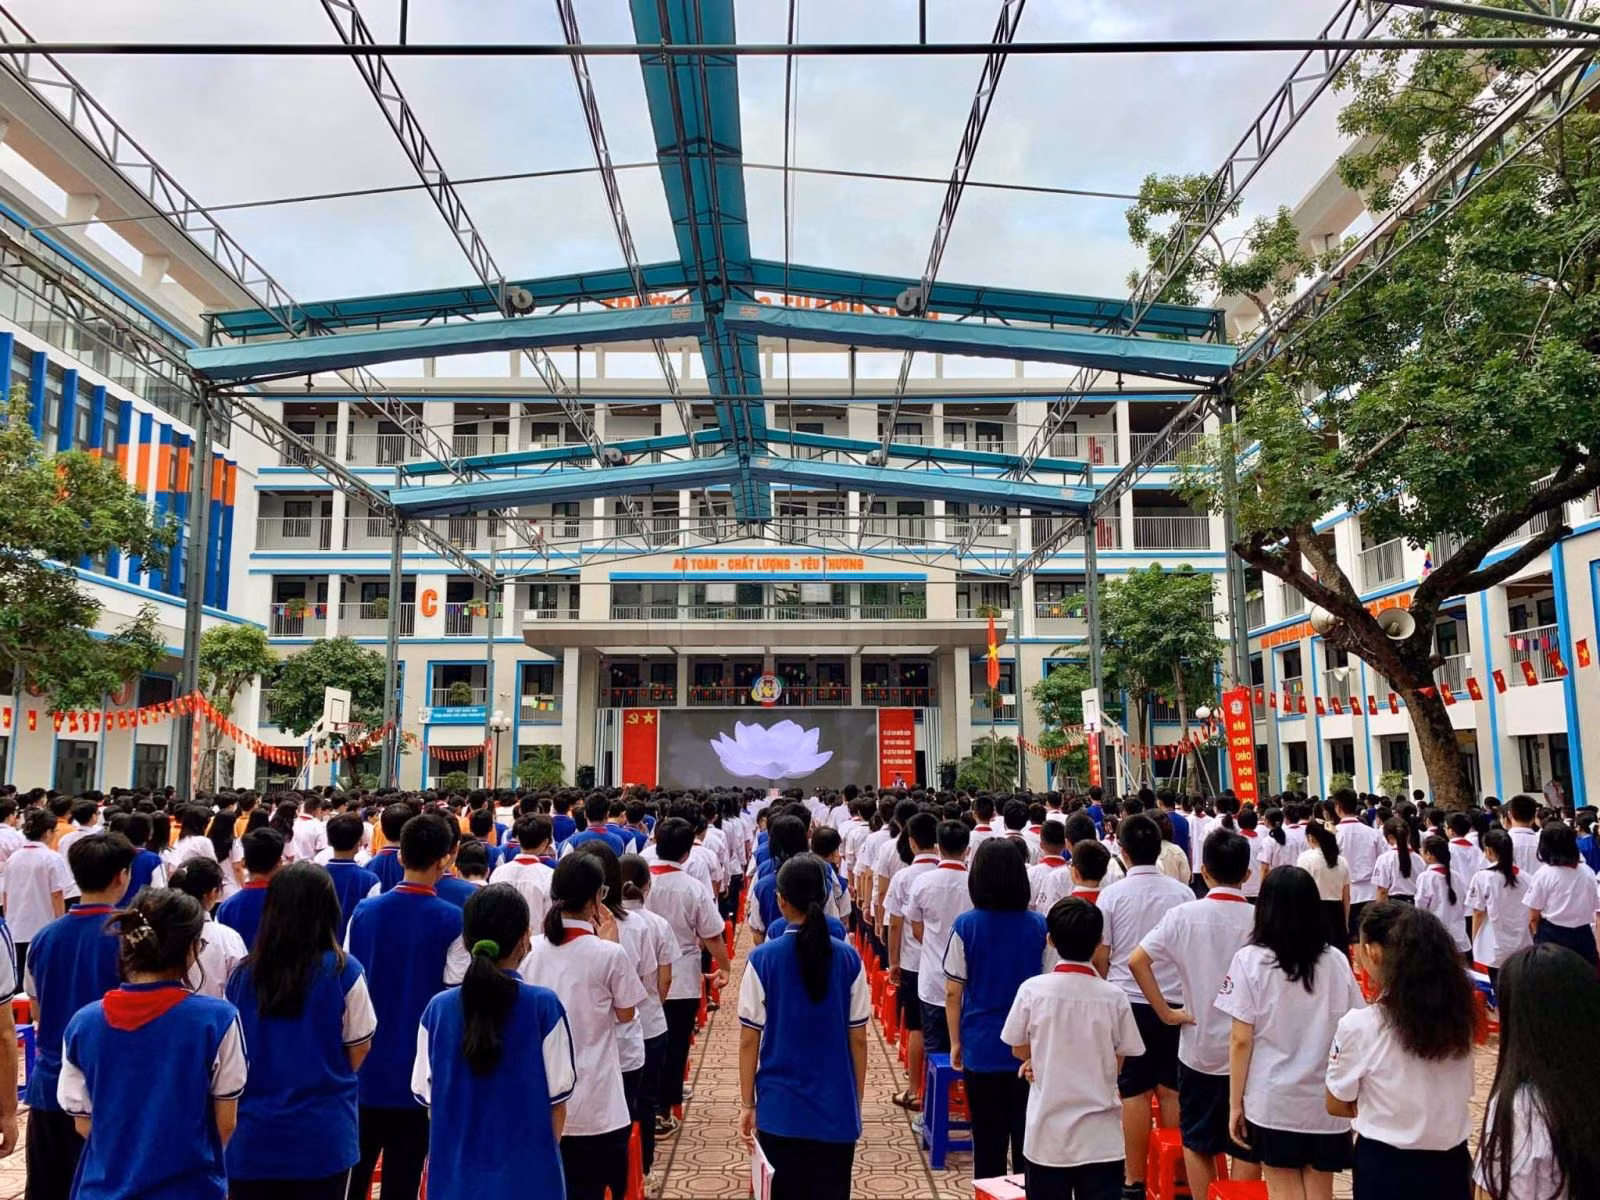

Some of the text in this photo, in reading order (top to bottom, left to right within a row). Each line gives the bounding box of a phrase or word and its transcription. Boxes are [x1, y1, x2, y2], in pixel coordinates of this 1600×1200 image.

[690, 556, 718, 570] TOÀN
[727, 555, 754, 570] CHẤT
[756, 557, 791, 572] LƯỢNG
[800, 556, 820, 570] YÊU
[421, 589, 437, 617] C
